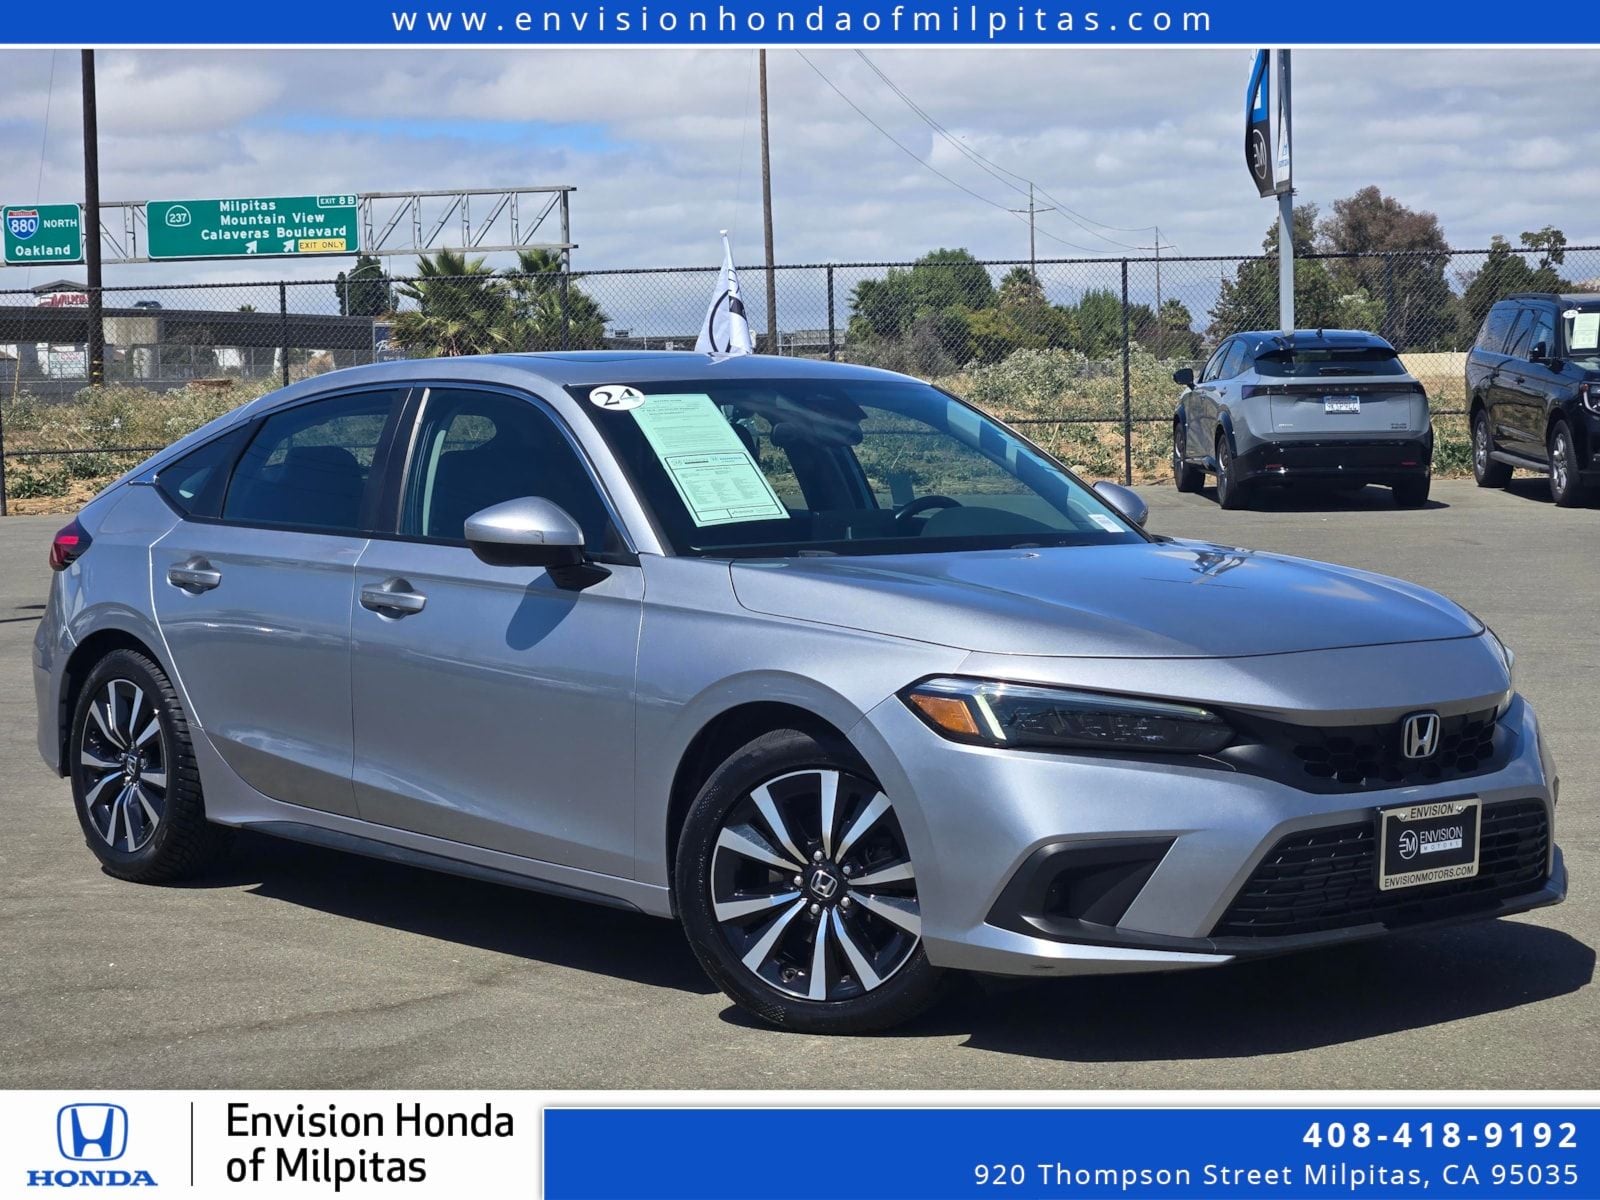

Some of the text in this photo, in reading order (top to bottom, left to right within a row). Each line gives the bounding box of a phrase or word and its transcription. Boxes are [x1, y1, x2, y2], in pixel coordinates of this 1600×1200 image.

[219, 200, 276, 213] Milpitas
[169, 213, 187, 223] 237
[220, 212, 325, 226] Mountain View
[11, 219, 78, 233] 880 NORTH
[201, 225, 347, 240] Calaveras Boulevard
[15, 244, 71, 256] Oakland
[321, 241, 345, 249] ONLY
[1410, 803, 1454, 819] ENVISION
[1420, 825, 1463, 844] ENVISION
[1384, 865, 1474, 888] ENVISIONMOTORS.COM
